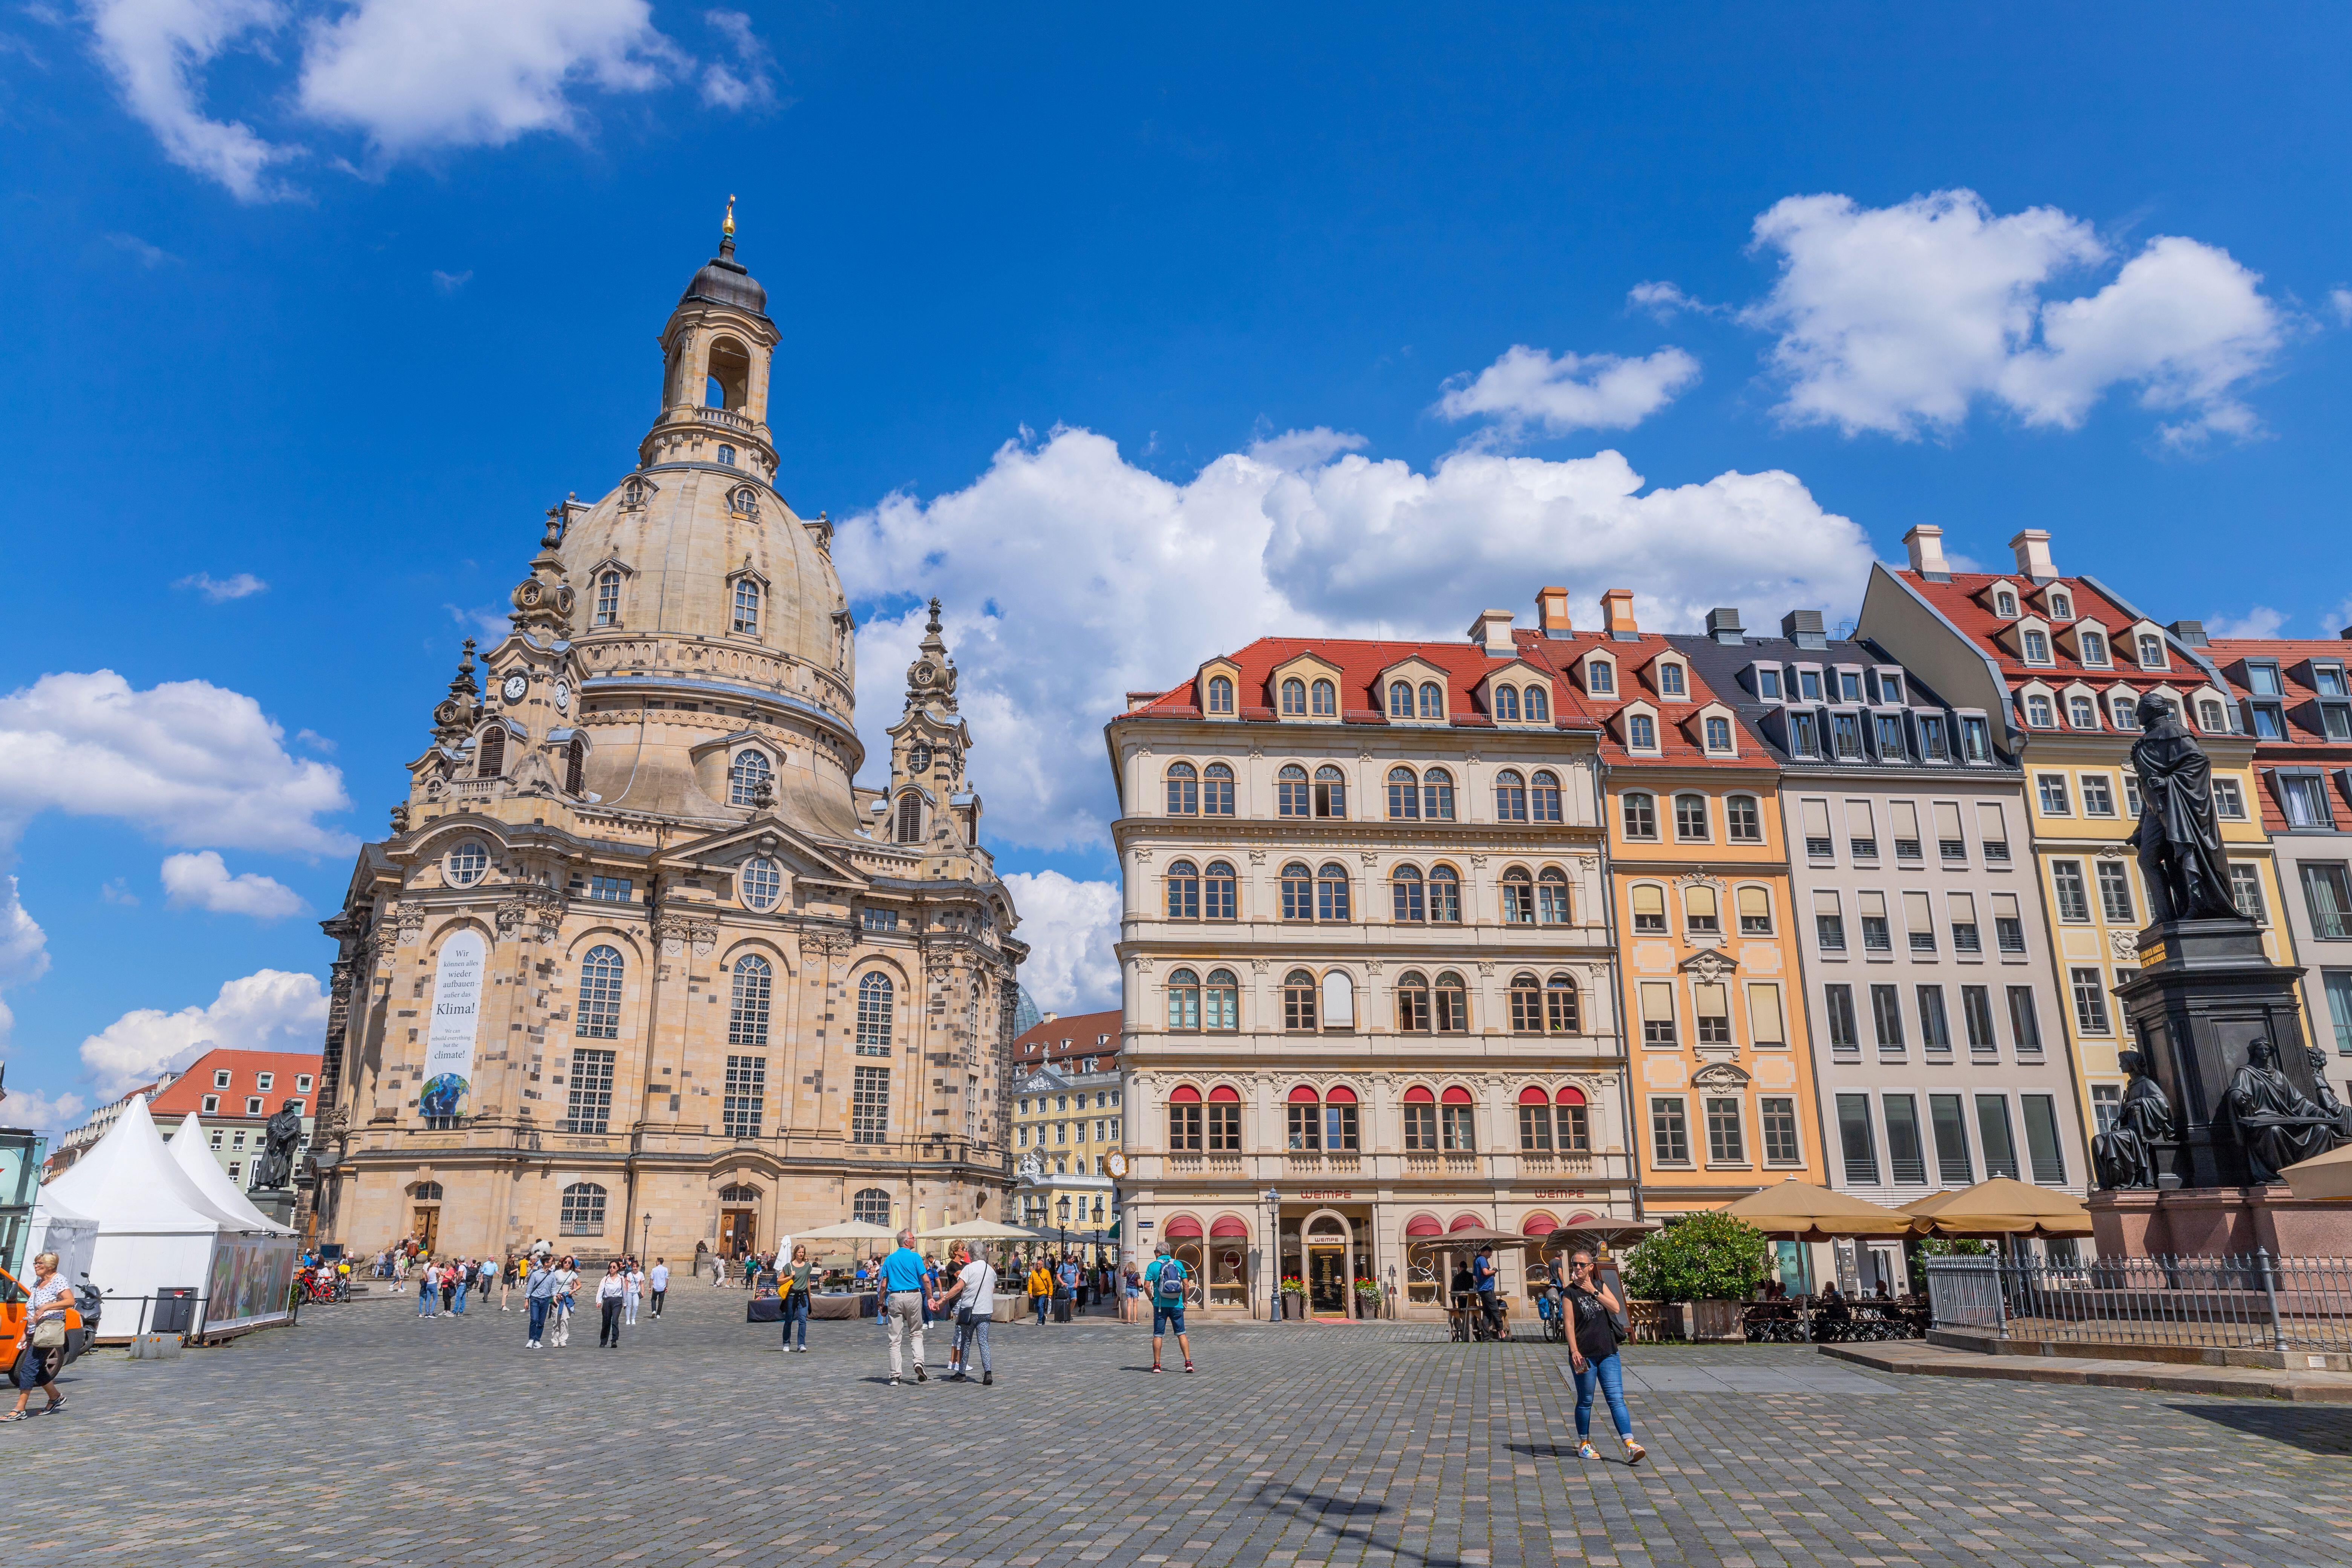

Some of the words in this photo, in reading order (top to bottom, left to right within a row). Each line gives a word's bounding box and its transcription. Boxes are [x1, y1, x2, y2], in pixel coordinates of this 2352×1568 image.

[436, 1003, 475, 1015] Klima!
[435, 1050, 465, 1059] climate!
[1301, 1190, 1351, 1199] WEMPE
[1535, 1190, 1584, 1198] WEMPE
